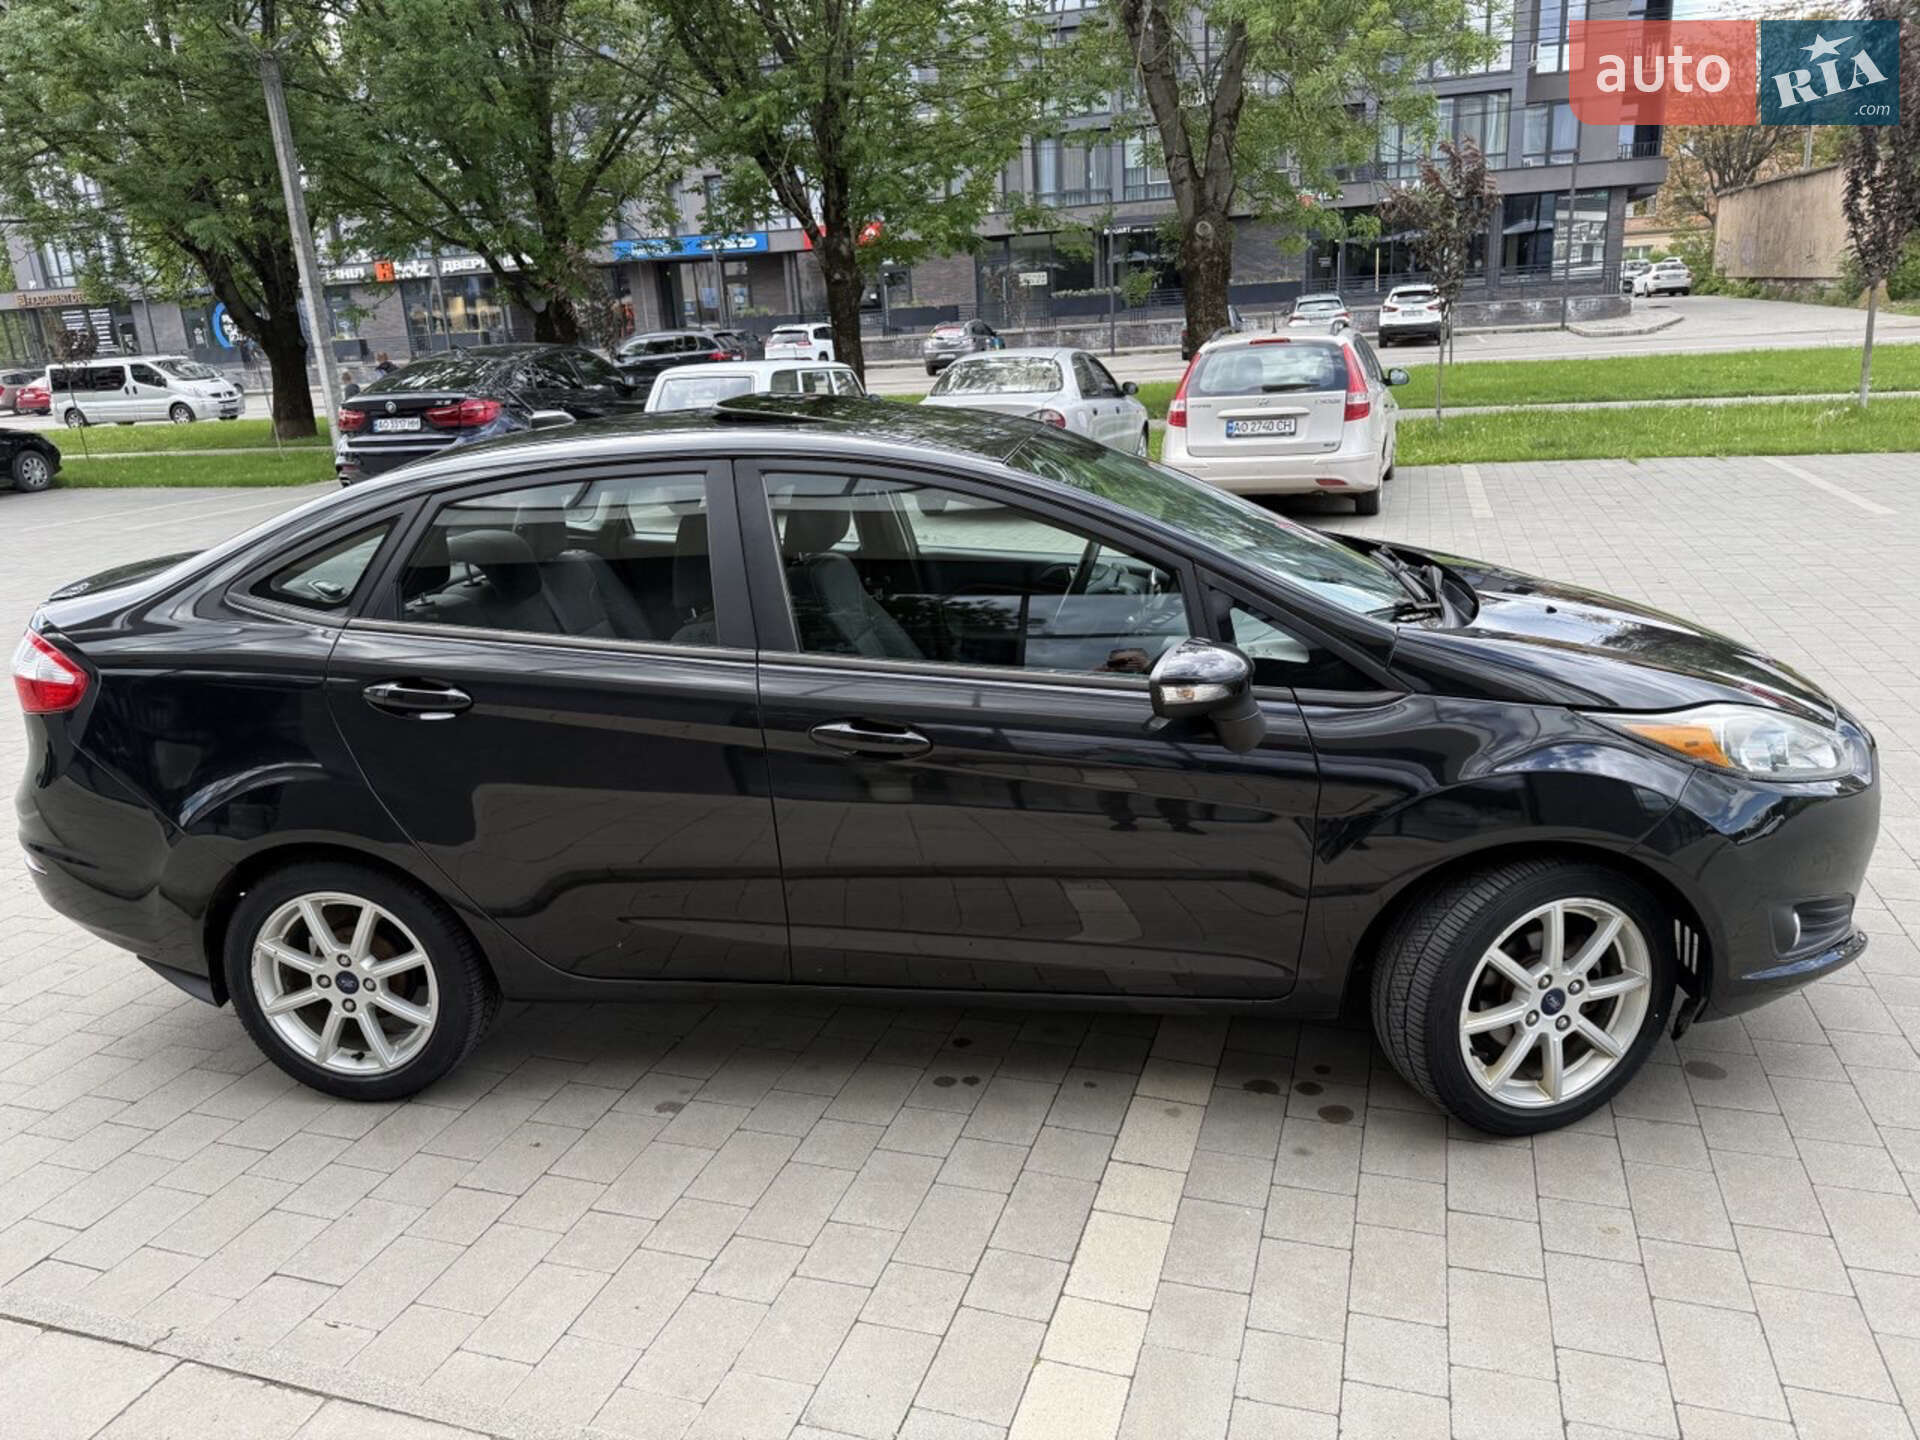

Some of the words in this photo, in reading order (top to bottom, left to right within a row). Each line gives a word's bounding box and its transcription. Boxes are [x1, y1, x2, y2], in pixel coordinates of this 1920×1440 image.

[1234, 421, 1248, 432] AO
[1250, 420, 1274, 431] 2740
[1276, 419, 1292, 430] CH
